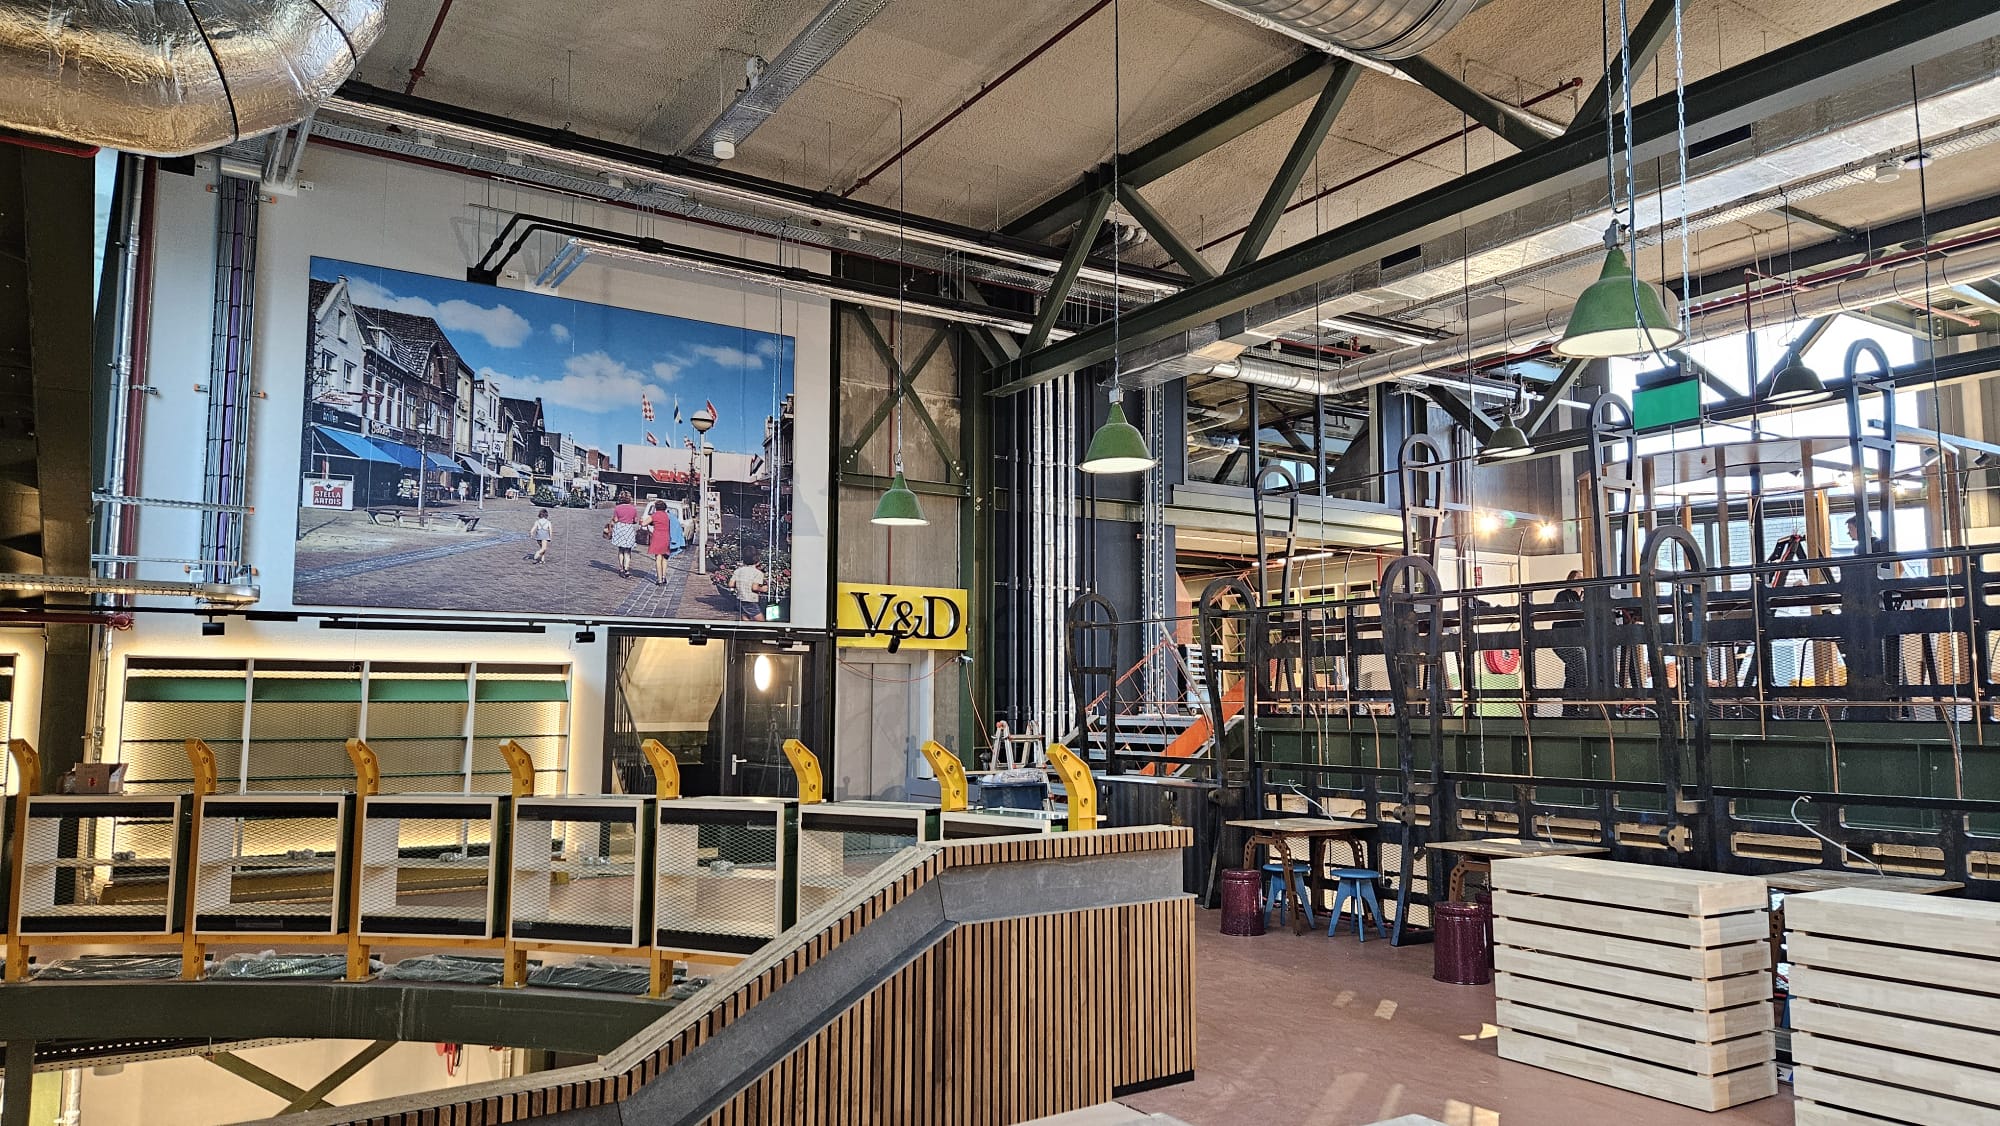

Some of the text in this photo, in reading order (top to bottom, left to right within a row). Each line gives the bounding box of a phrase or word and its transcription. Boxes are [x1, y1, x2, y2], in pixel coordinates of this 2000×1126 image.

[314, 490, 341, 499] STELLA
[313, 497, 342, 505] ARTOIS
[849, 591, 961, 640] V&D
